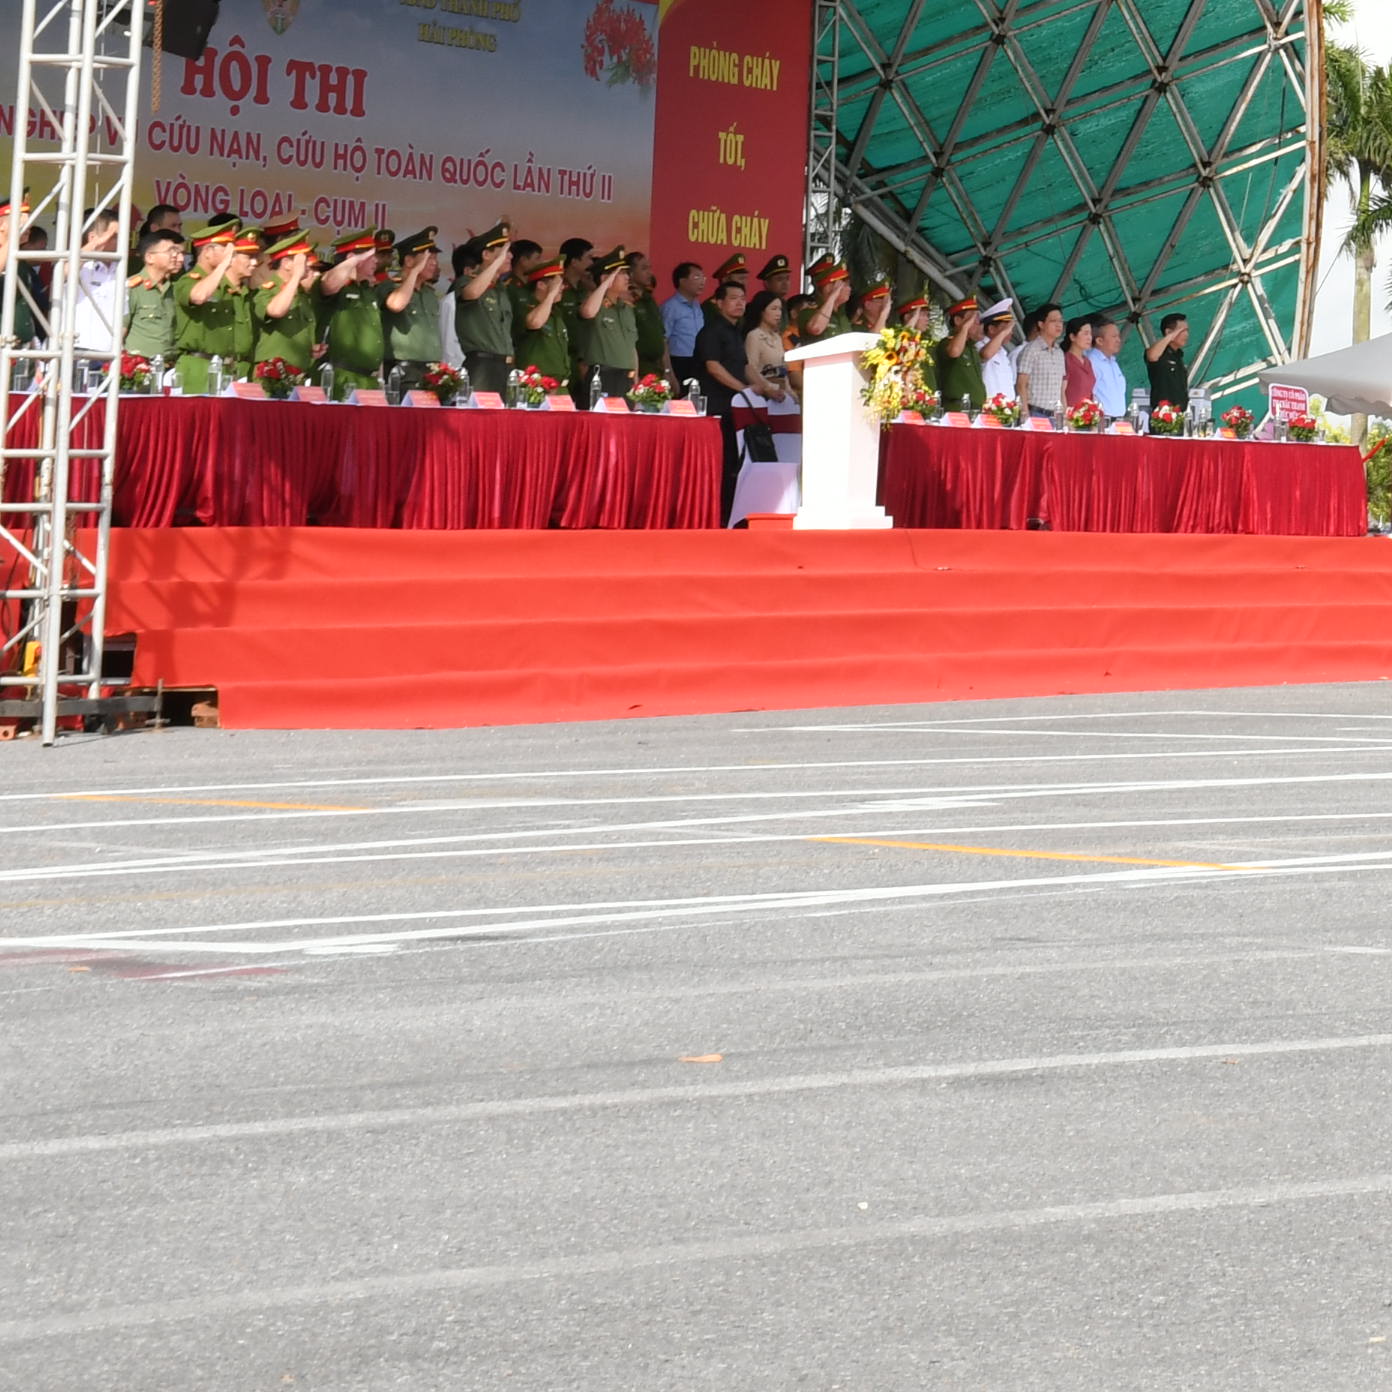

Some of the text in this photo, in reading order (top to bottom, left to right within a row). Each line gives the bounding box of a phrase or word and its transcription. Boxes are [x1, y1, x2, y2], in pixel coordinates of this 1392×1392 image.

[181, 34, 368, 117] HỘI THI
[689, 41, 781, 91] PHÒNG CHÁY
[148, 115, 200, 155] CỨU
[210, 127, 267, 168] NẠN,
[277, 130, 325, 169] CỨU
[334, 138, 367, 182] HỘ
[374, 144, 433, 181] TOÀN
[441, 148, 505, 189] QUỐC
[513, 151, 551, 195] LẦN
[558, 164, 596, 200] THỨ
[601, 174, 614, 201] II
[718, 122, 746, 170] TỐT,
[155, 174, 230, 214] VÒNG
[314, 197, 367, 236] CỤM
[688, 206, 769, 249] CHỮA CHÁY
